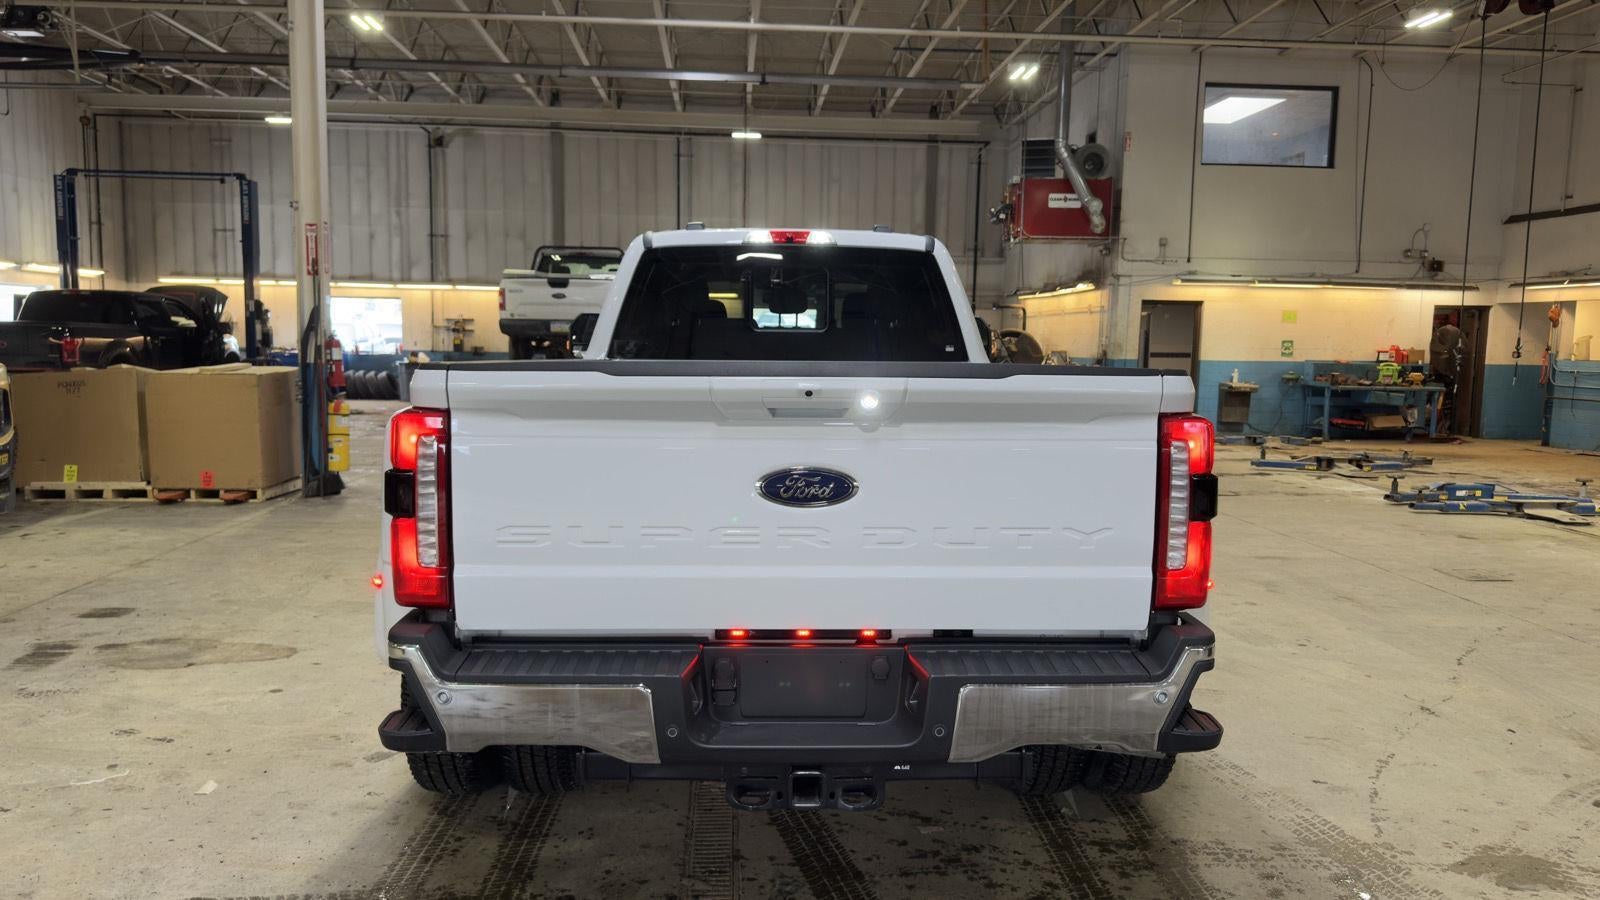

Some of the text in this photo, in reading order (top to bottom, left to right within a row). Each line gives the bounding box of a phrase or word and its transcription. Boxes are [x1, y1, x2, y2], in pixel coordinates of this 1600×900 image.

[780, 475, 834, 498] Ford
[496, 525, 1113, 549] SUPER DUTY
